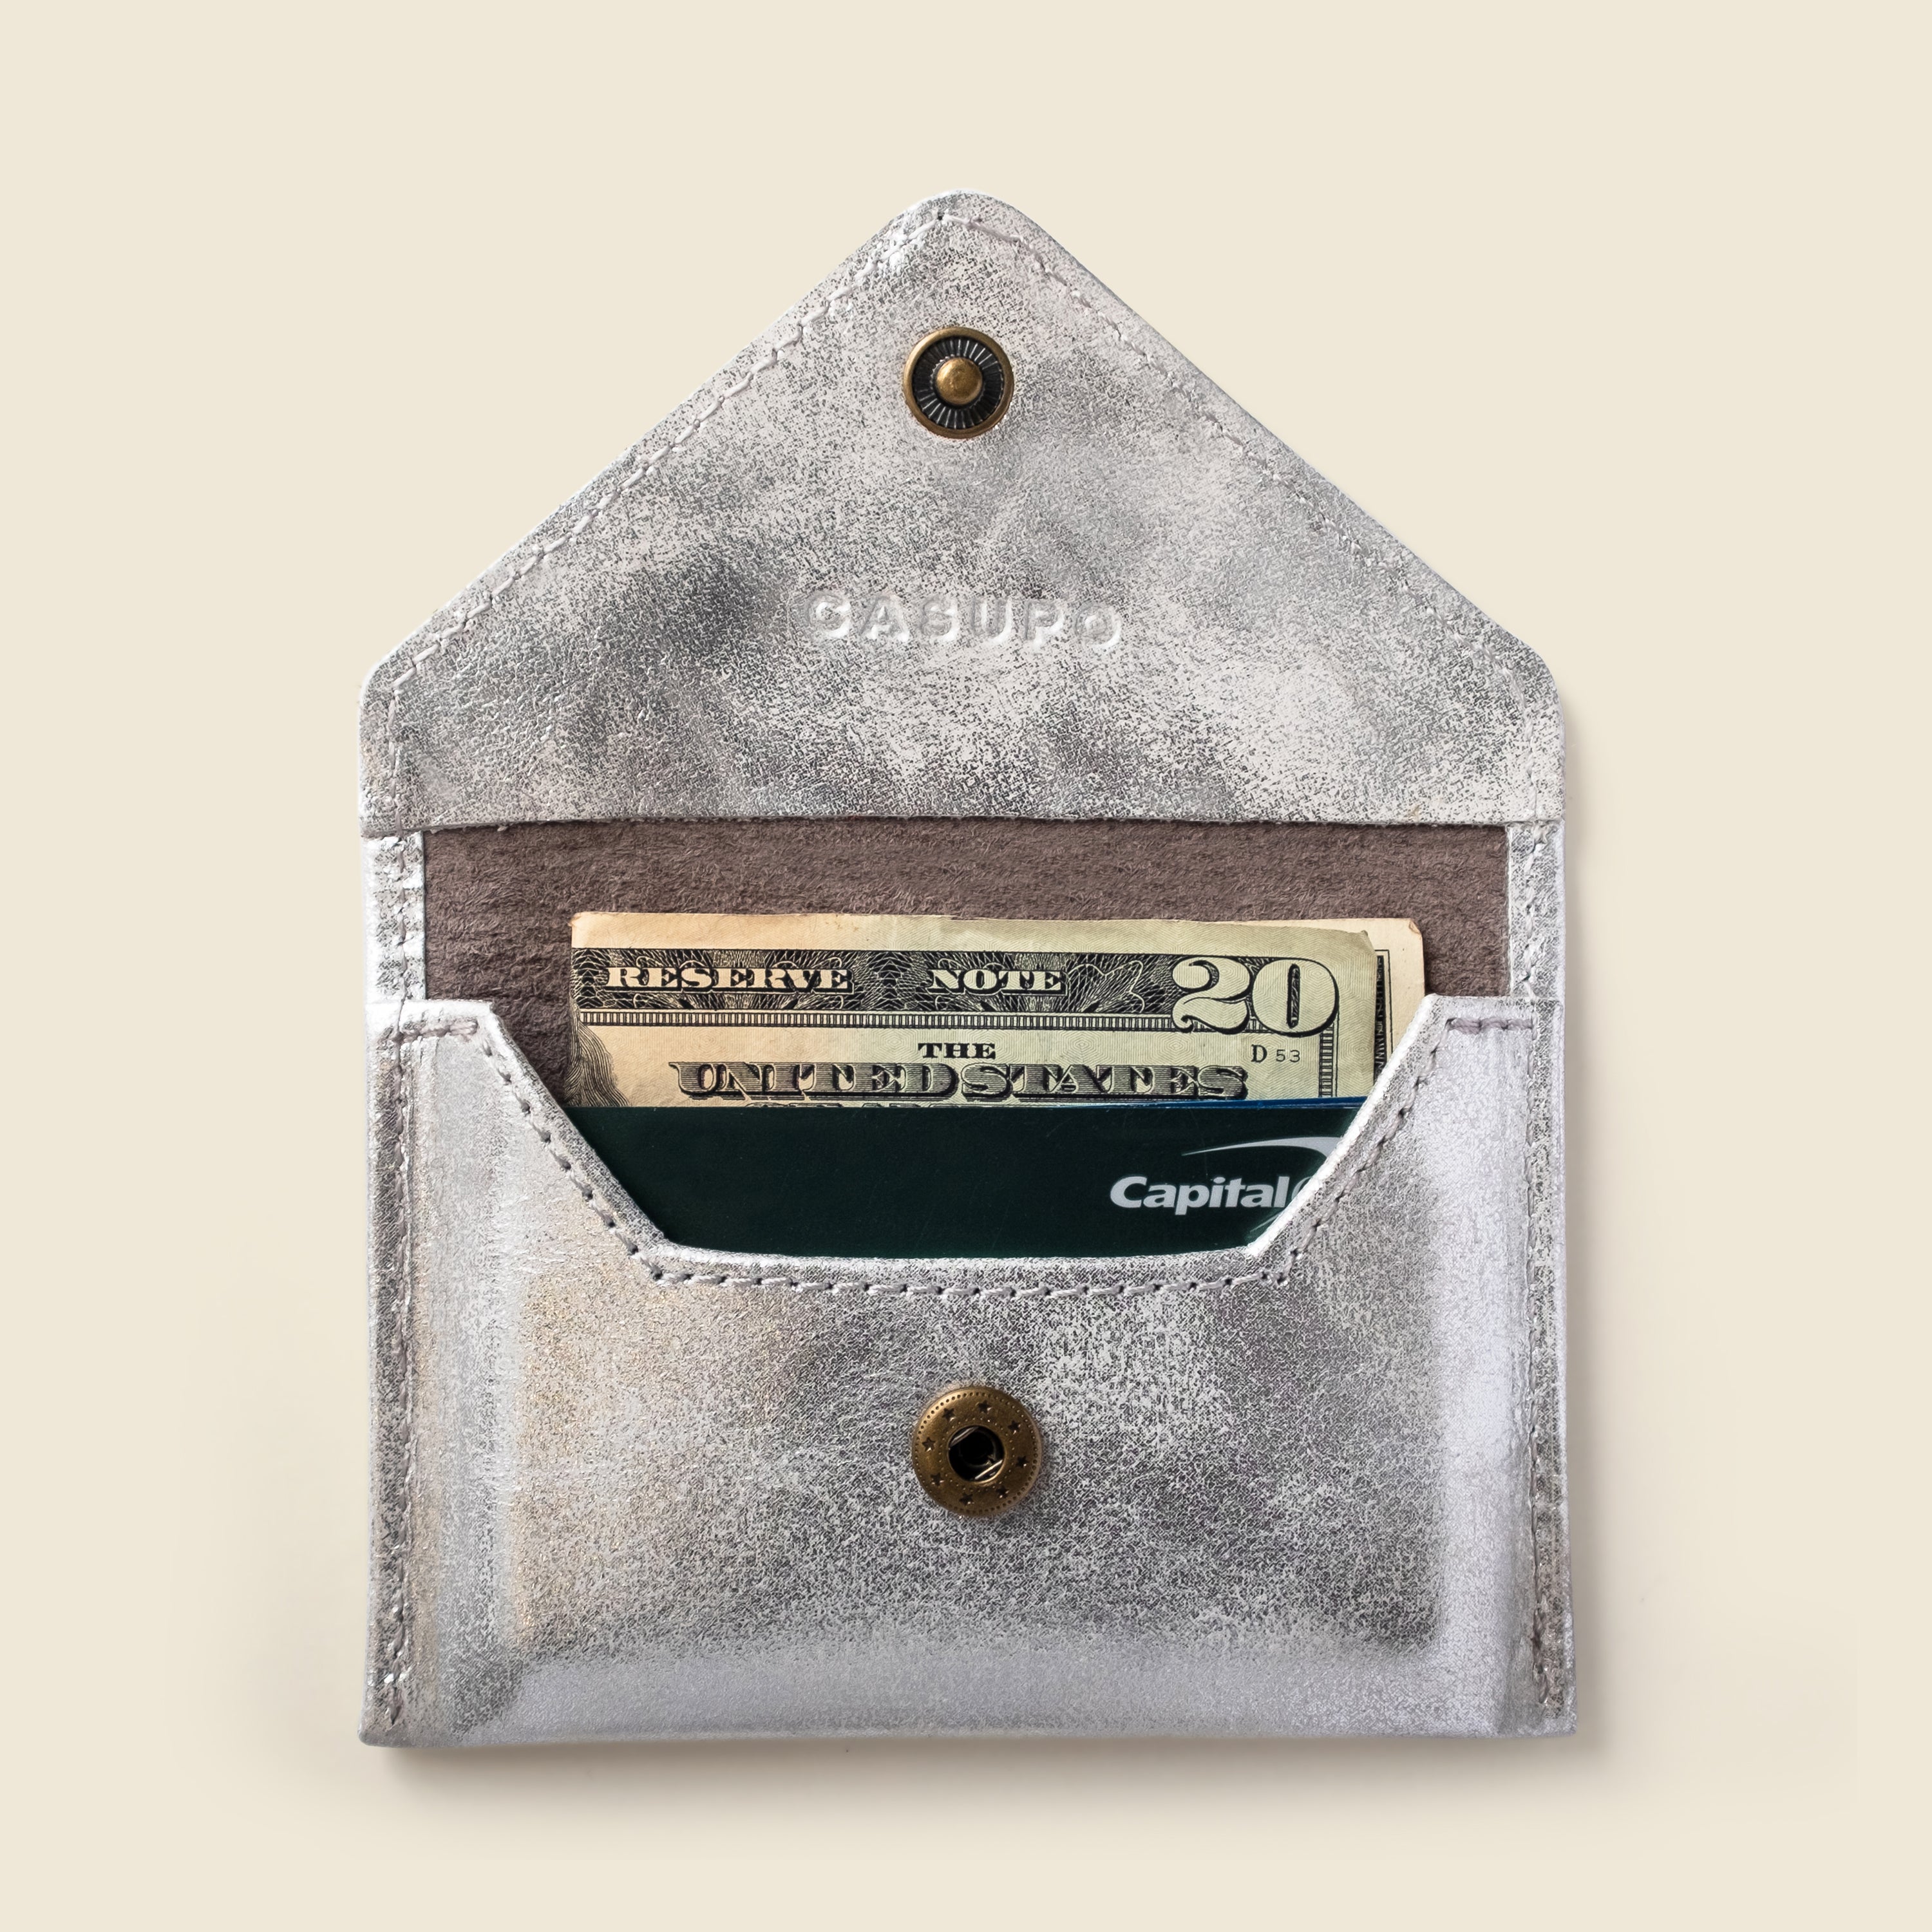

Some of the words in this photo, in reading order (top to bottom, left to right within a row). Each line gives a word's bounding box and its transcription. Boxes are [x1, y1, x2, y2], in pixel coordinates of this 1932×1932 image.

[805, 591, 1122, 648] CASUPO
[606, 967, 853, 993] RESERVE
[929, 969, 1065, 996] NOTE
[1172, 956, 1340, 1036] 20
[918, 1043, 996, 1059] THE
[1251, 1044, 1267, 1062] D
[1276, 1048, 1301, 1063] 53
[668, 1061, 959, 1101] UNITED
[960, 1063, 1248, 1101] STATES
[1110, 1175, 1291, 1216] Capital
